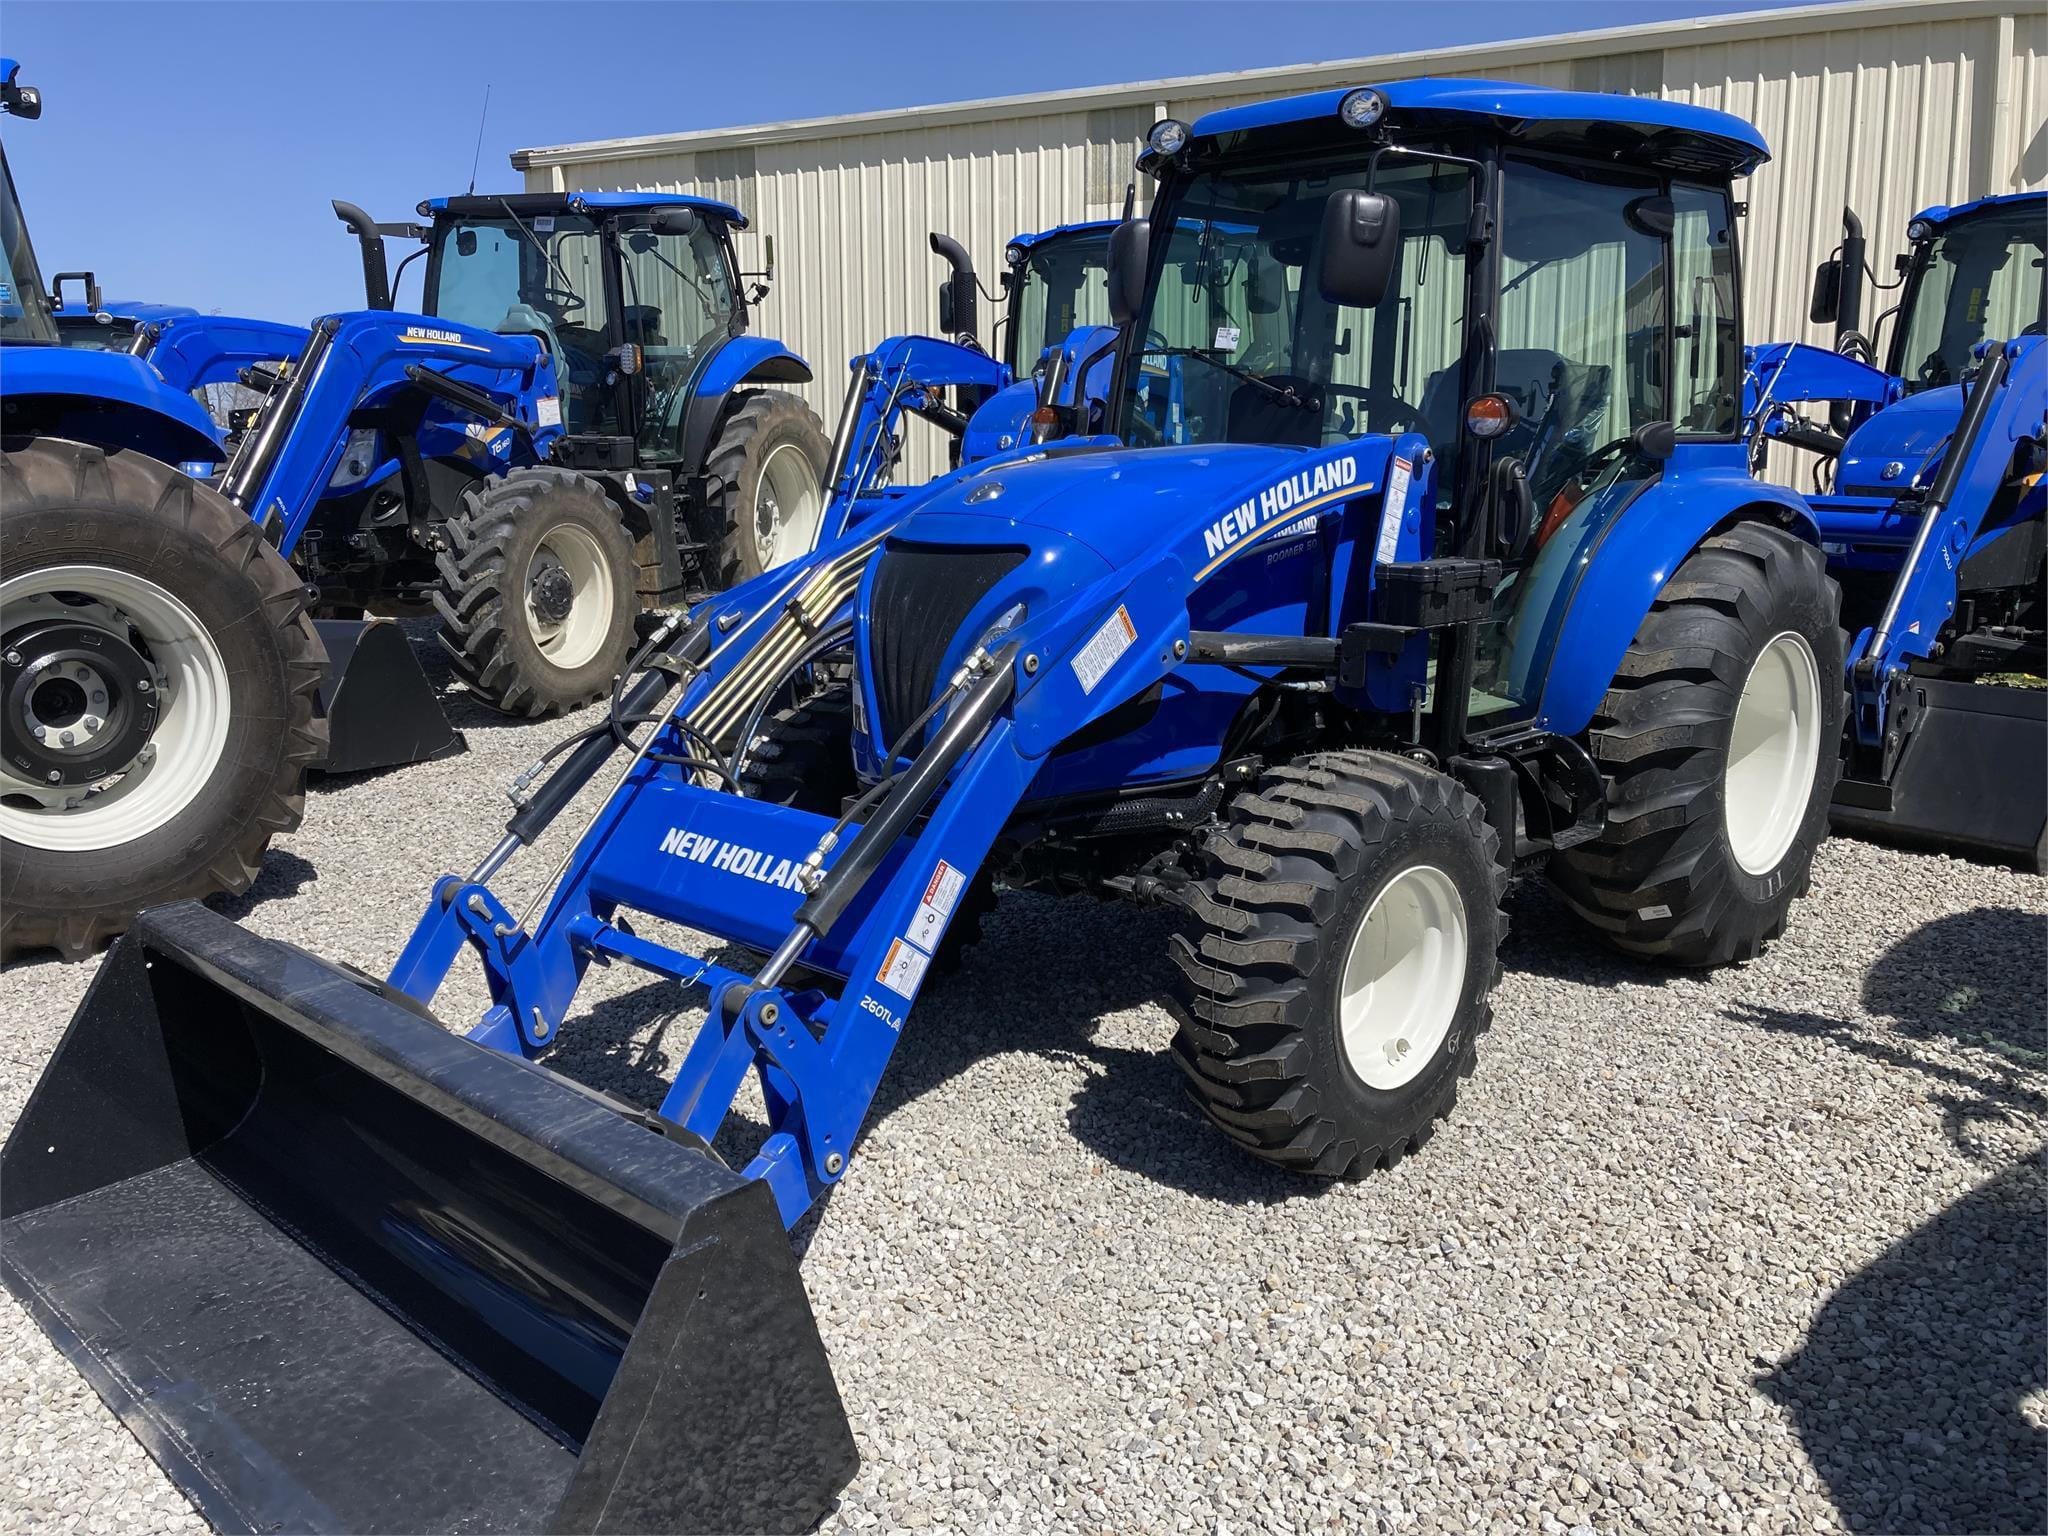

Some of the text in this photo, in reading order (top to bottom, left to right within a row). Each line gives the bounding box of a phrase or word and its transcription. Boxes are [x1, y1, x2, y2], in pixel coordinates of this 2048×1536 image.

[407, 327, 461, 342] NEW HOLLAND
[1203, 498, 1257, 558] NEW
[1260, 456, 1357, 520] HOLLAND
[1266, 543, 1304, 565] BOOMER
[659, 827, 720, 864] NEW
[929, 865, 945, 894] DANGER
[860, 995, 902, 1032] 260TLA
